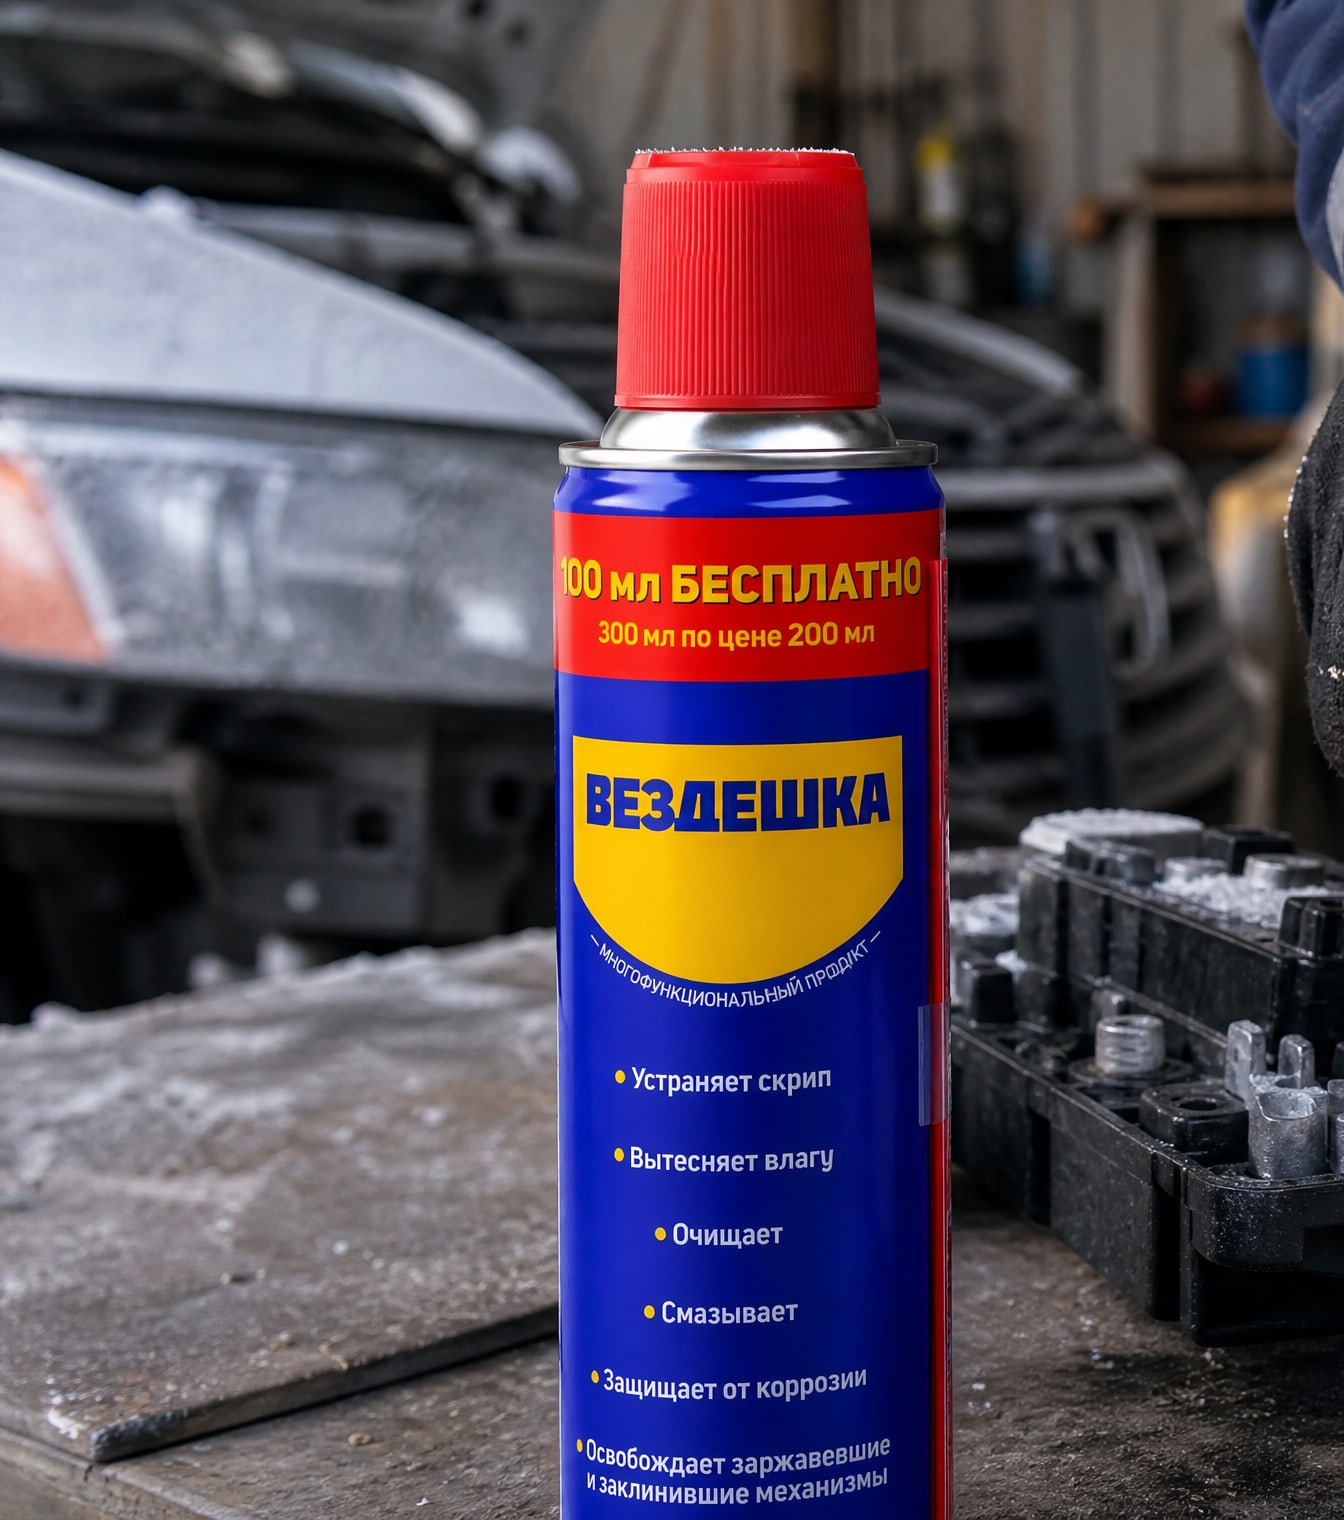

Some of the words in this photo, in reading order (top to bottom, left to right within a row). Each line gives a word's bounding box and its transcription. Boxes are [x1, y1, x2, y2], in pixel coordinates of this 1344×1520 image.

[560, 557, 602, 599] 100
[610, 571, 659, 602] мл
[671, 556, 921, 604] БЕСПЛАТНО
[599, 620, 638, 645] 300
[644, 629, 674, 647] мл
[682, 630, 711, 647] по
[719, 630, 781, 651] цене
[789, 622, 837, 646] 200
[846, 626, 874, 643] мл
[586, 773, 890, 832] ВЕЗДЕШКА
[600, 943, 804, 1007] МНОГОФУНКЦИОНАЛЬНЫЙ
[632, 1067, 752, 1097] Устраняет
[759, 1070, 830, 1096] скрип
[631, 1146, 758, 1172] Вытесняет
[766, 1150, 833, 1172] влагу
[673, 1223, 783, 1249] Очищает
[662, 1301, 798, 1324] Смазывает
[604, 1368, 717, 1402] Защищает
[724, 1383, 750, 1399] от
[757, 1369, 866, 1401] коррозии
[586, 1439, 726, 1477] Освобождает
[731, 1438, 891, 1478] заржавевшие
[587, 1472, 595, 1490] и
[599, 1476, 750, 1505] заклинившие
[756, 1467, 888, 1504] механизмы
